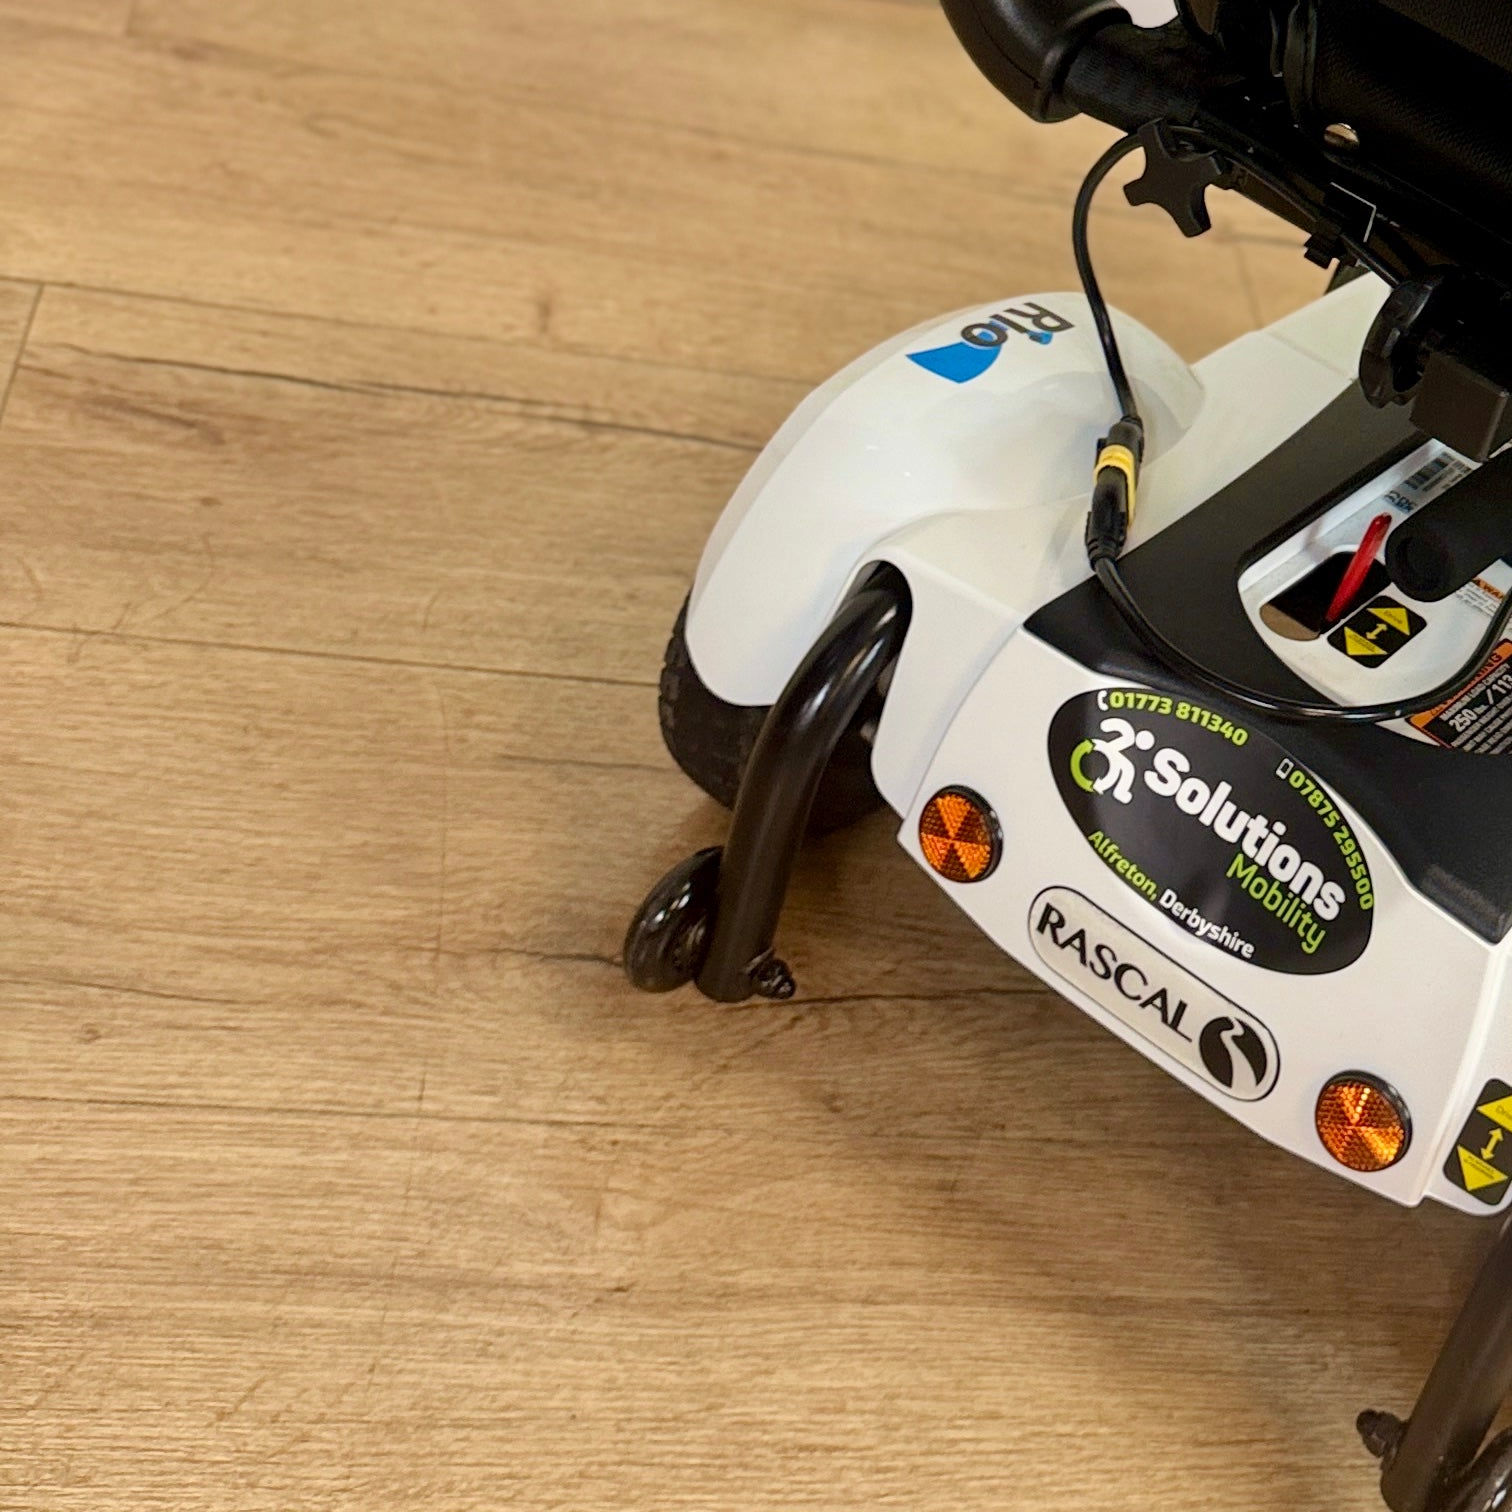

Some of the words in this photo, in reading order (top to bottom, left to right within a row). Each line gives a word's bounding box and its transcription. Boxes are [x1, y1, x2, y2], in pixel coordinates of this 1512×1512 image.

[961, 301, 1076, 348] Rio
[1109, 691, 1172, 716] 01773
[1175, 701, 1249, 746] 811340
[1448, 708, 1478, 733] 250
[1144, 747, 1346, 921] Solutions
[1289, 770, 1337, 828] 07875
[1333, 826, 1374, 911] 295500
[1088, 830, 1159, 901] Alfreton,
[1159, 888, 1255, 959] Derbyshire
[1226, 853, 1326, 955] Mobility
[1036, 902, 1193, 1044] RASCAL
